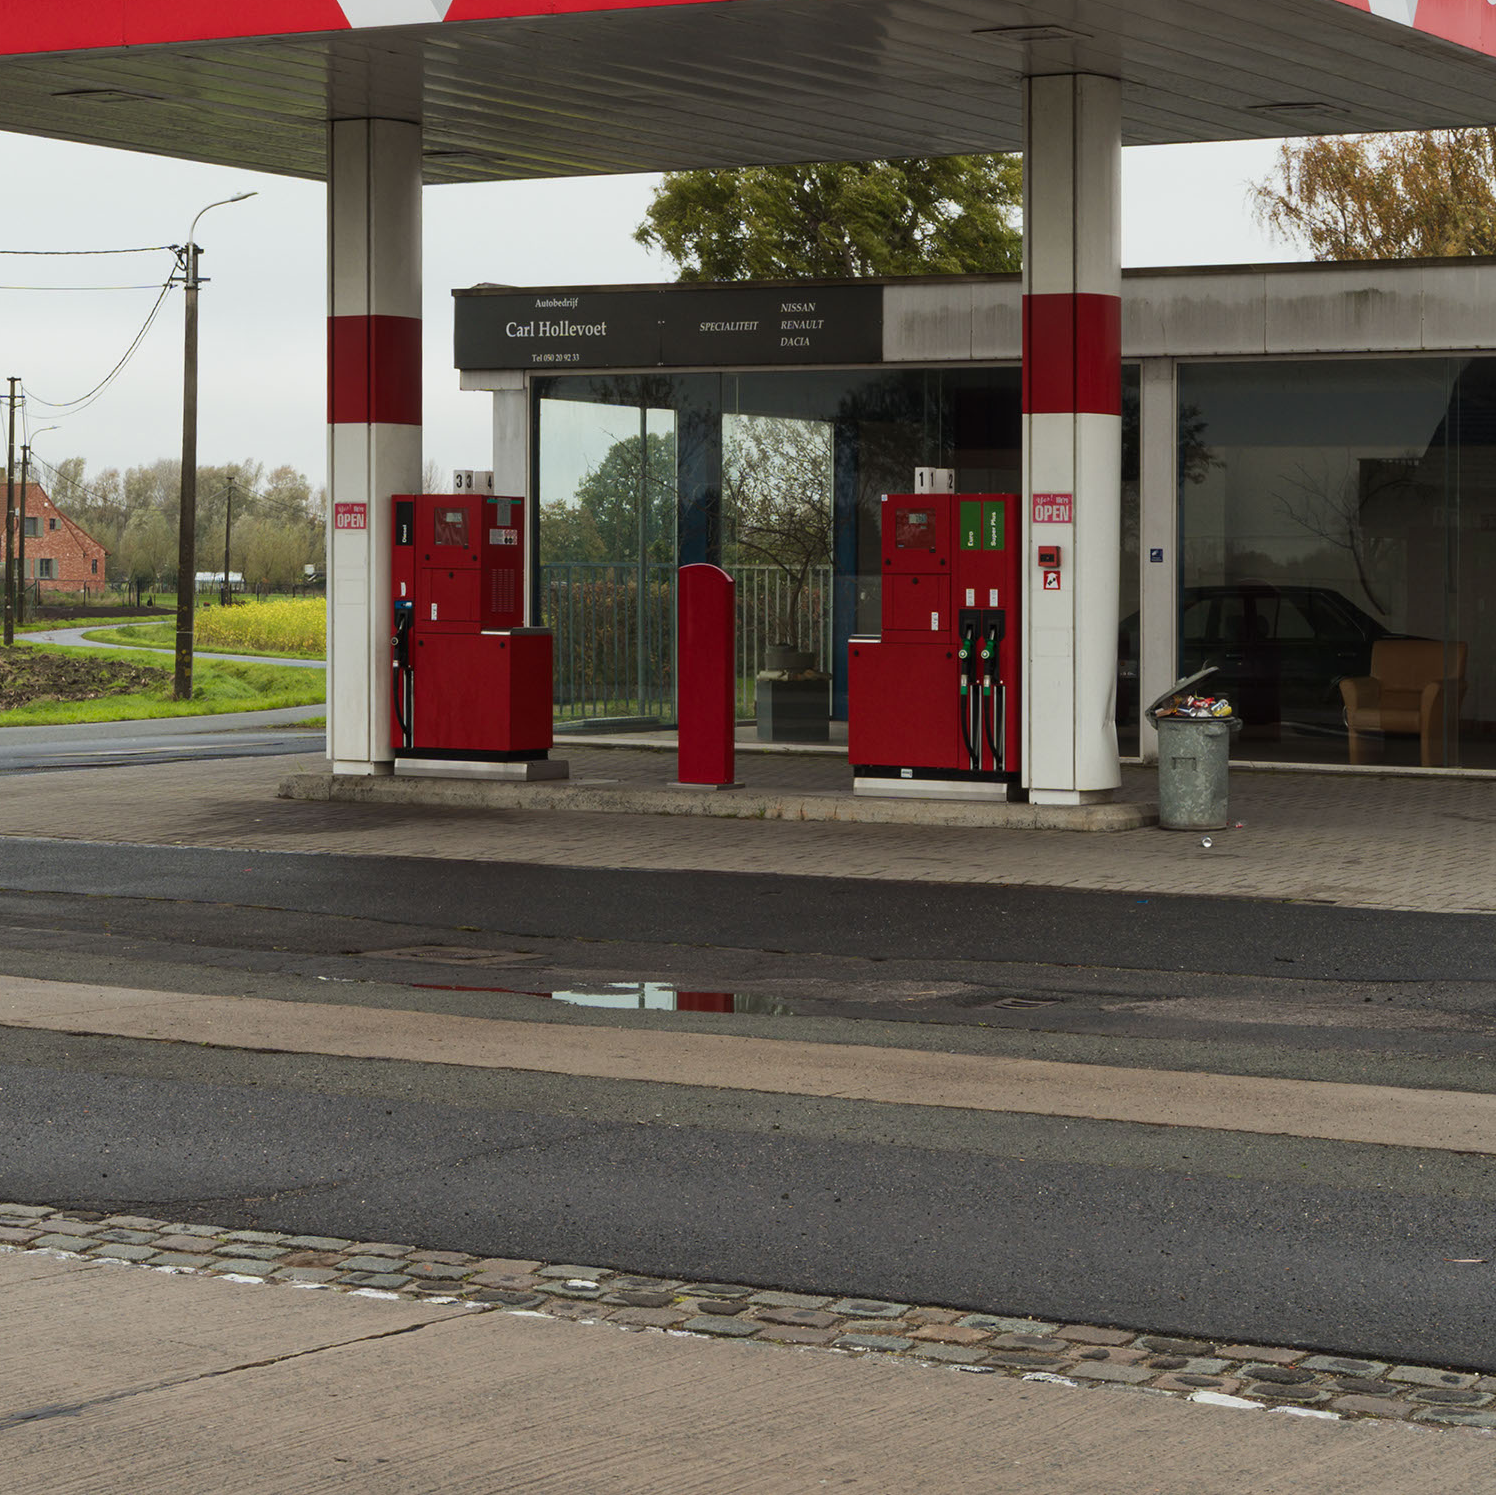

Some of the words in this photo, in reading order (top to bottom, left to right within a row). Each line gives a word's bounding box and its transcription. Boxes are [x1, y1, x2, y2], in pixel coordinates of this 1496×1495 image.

[535, 297, 579, 309] Autobedrijf
[780, 302, 816, 312] NISSAN
[505, 321, 534, 337] Carl
[538, 320, 607, 337] Hollevoet
[699, 321, 759, 331] SPECIALITEIT
[780, 320, 824, 330] RENAULT
[780, 337, 810, 346] DACIA
[531, 353, 543, 362] Tel
[555, 353, 563, 362] 20
[563, 353, 572, 362] 92
[572, 353, 580, 362] 33
[456, 474, 463, 488] 3
[466, 474, 472, 488] 3
[487, 475, 492, 489] 4
[919, 472, 924, 487] 1
[930, 472, 934, 487] 1
[948, 474, 953, 489] 2
[1035, 505, 1069, 521] OPEN
[337, 513, 364, 528] OPEN
